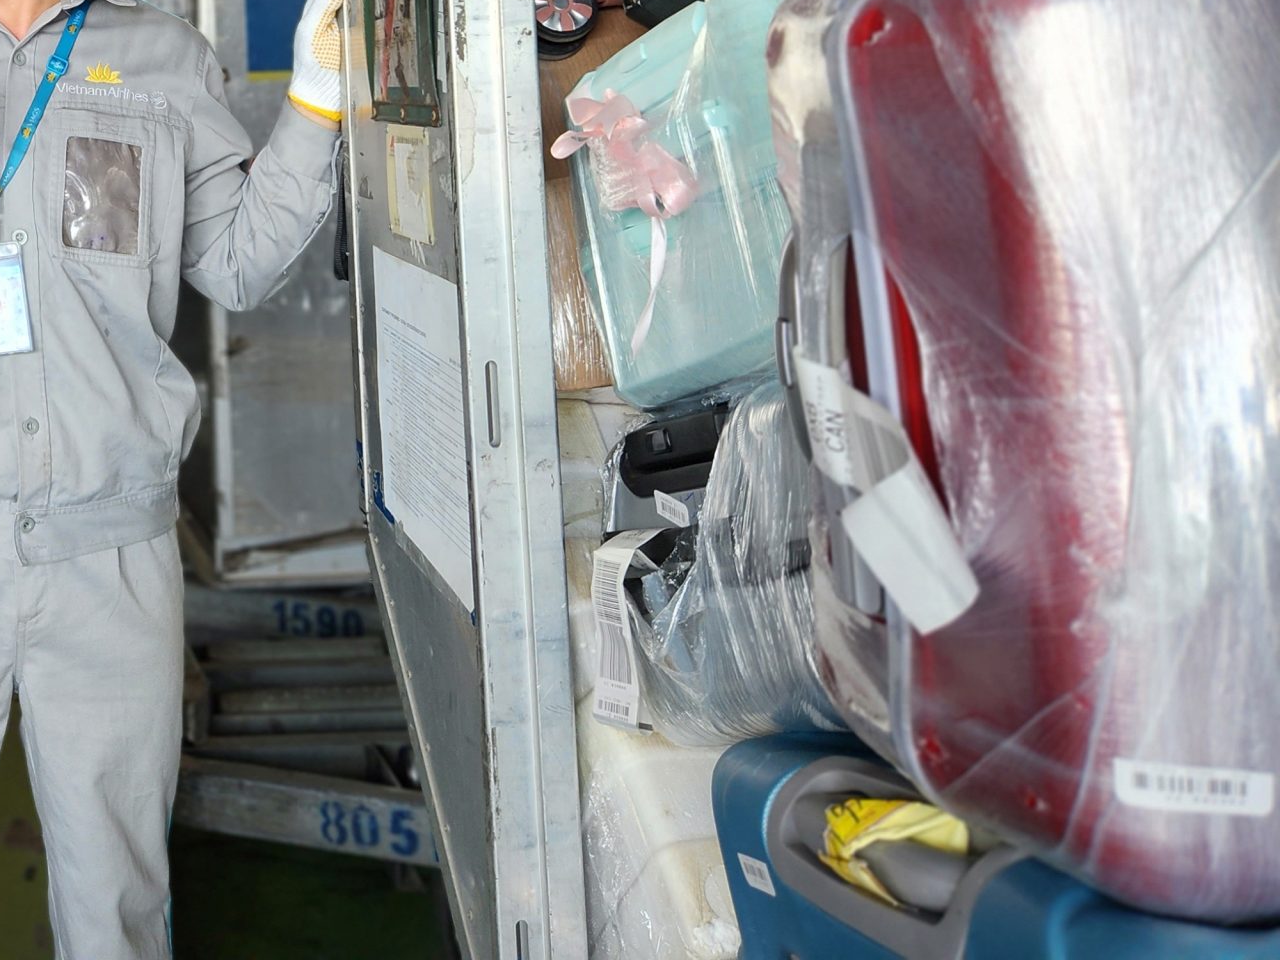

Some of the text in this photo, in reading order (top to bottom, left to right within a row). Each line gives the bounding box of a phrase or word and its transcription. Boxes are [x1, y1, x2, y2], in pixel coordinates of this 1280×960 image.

[56, 82, 150, 103] Vietnam Airlines
[824, 408, 845, 454] CAN
